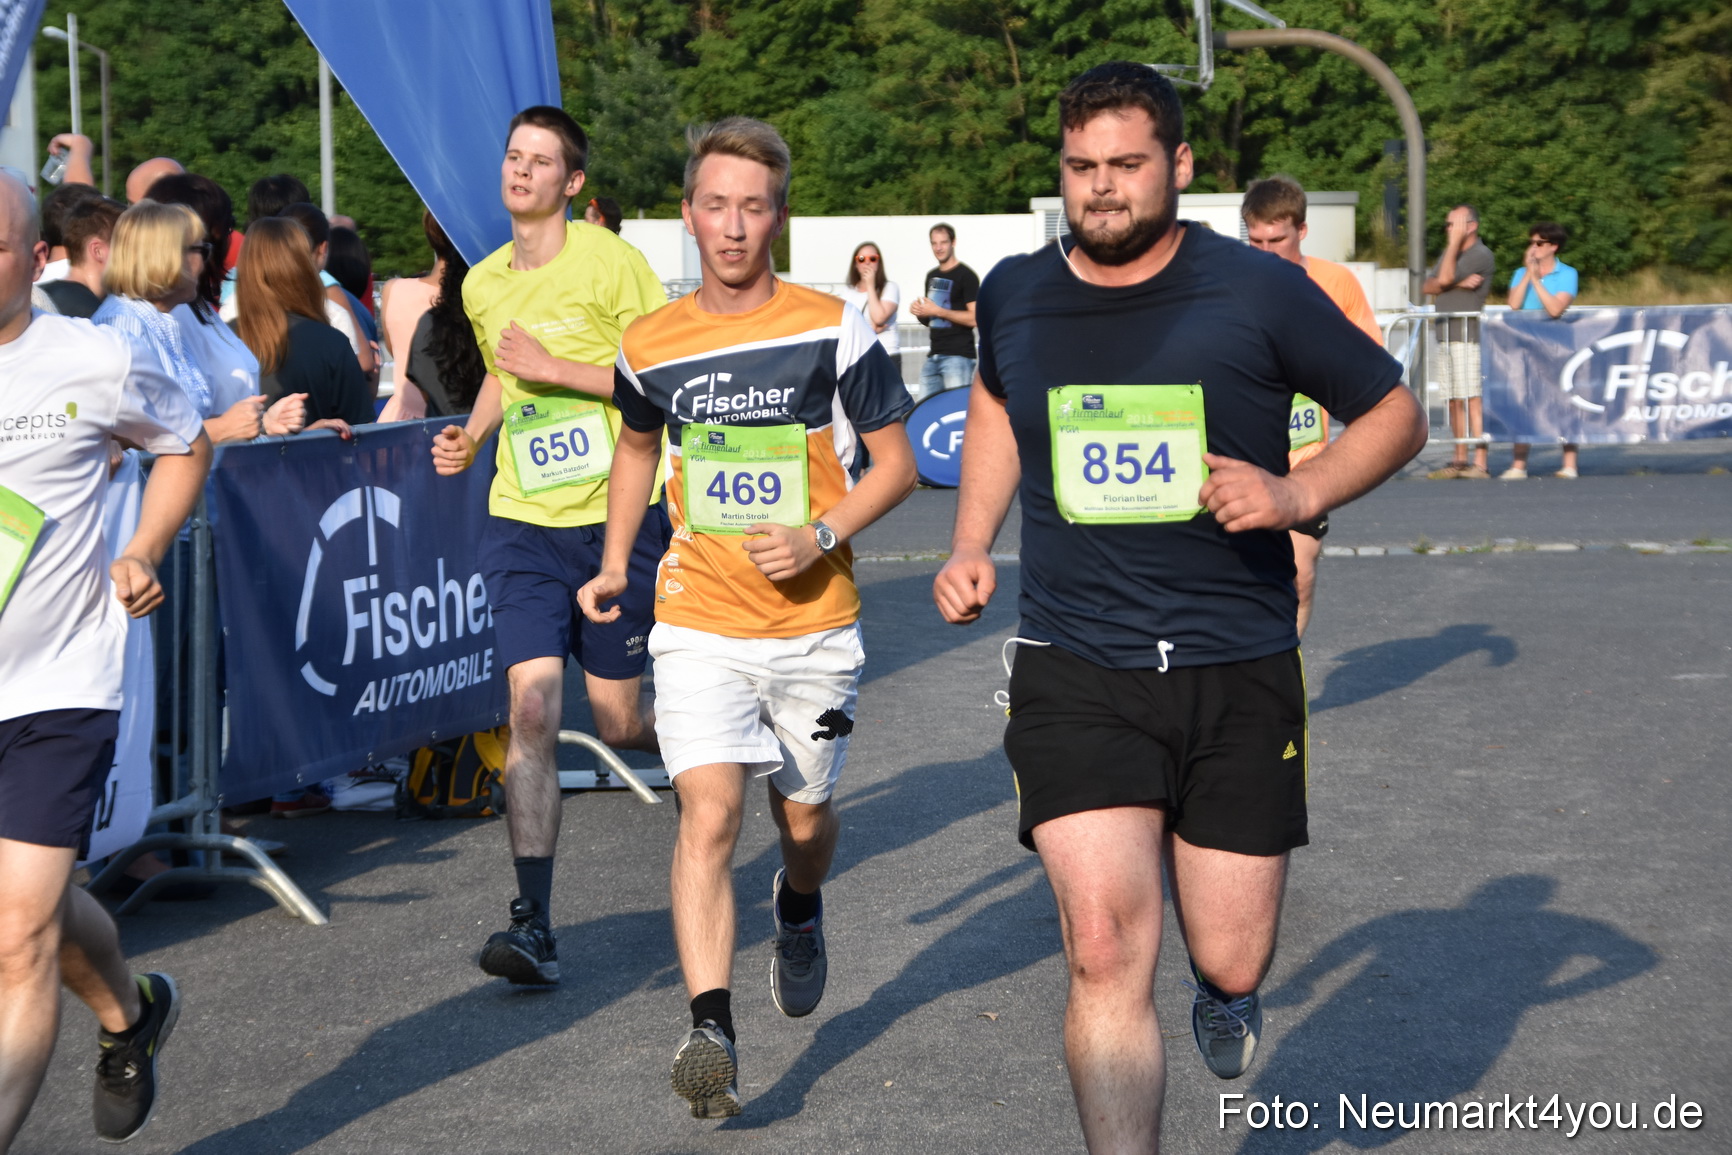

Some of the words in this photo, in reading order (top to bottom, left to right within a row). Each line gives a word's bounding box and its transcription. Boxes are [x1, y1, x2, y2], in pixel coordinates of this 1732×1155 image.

[1604, 361, 1732, 400] Fisch
[692, 386, 795, 416] Fischer
[0, 412, 66, 433] cepts
[705, 406, 789, 425] AUTOMOBILE
[1072, 408, 1125, 418] firmenlauf
[1289, 408, 1316, 431] 48
[529, 427, 590, 467] 650
[701, 442, 741, 453] firmenlauf
[541, 470, 563, 479] Markus
[563, 462, 590, 474] Batzdorf
[1083, 441, 1176, 485] 854
[706, 470, 782, 505] 469
[1103, 494, 1135, 502] Florian
[1137, 494, 1158, 502] Iberl
[721, 512, 744, 520] Martin
[746, 512, 769, 520] Strobl
[352, 647, 494, 716] AUTOMOBILE
